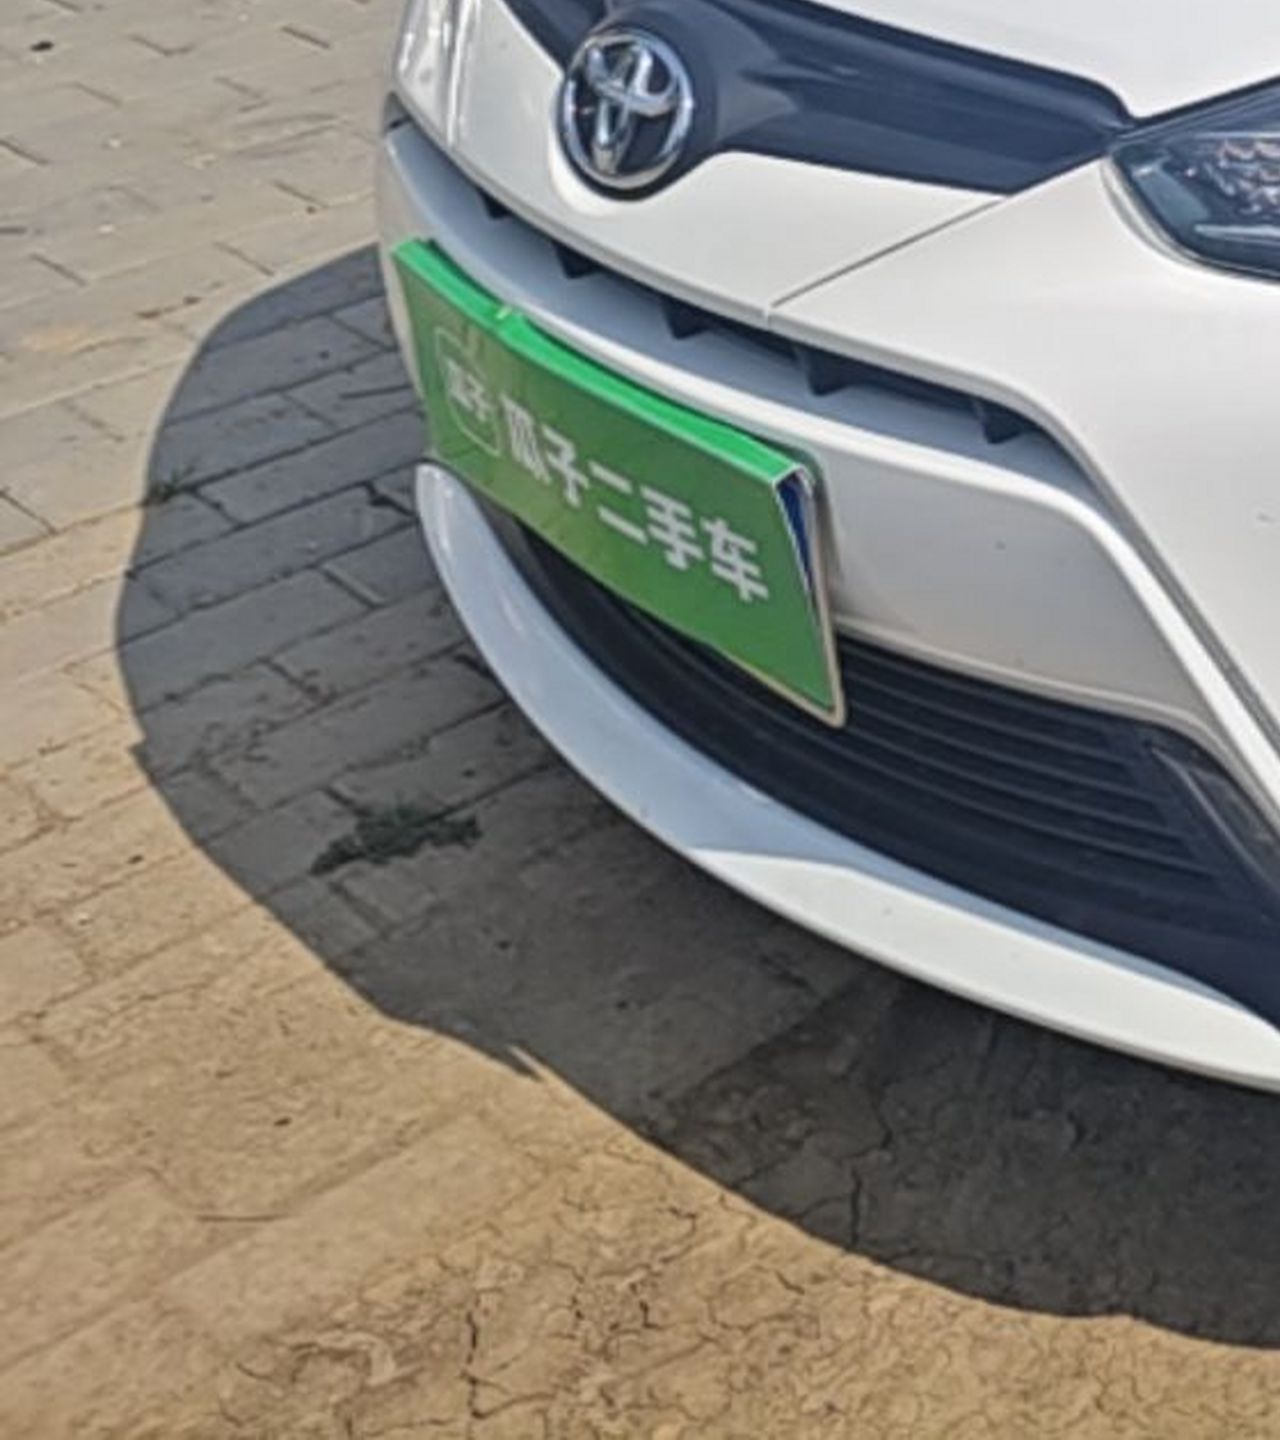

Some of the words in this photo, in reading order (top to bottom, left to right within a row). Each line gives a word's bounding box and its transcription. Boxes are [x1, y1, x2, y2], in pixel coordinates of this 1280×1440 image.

[500, 394, 769, 603] 瓜子二手车
